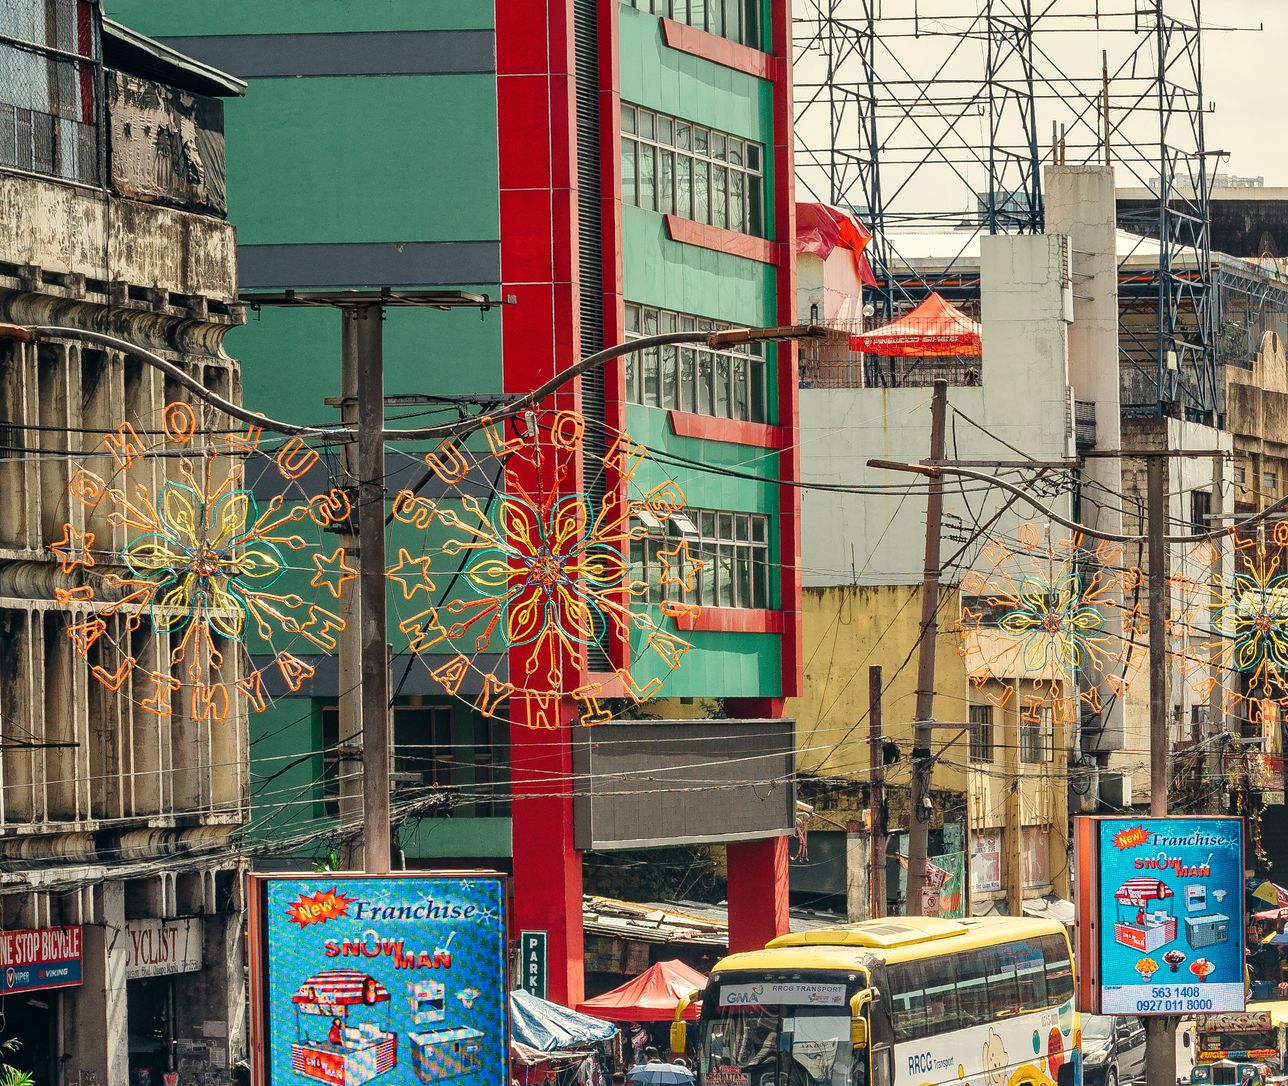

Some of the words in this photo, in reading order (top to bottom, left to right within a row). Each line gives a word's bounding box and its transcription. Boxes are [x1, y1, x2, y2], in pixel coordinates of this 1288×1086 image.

[1119, 831, 1144, 847] New!
[1153, 834, 1225, 847] Franchise
[1134, 852, 1182, 870] SNOW
[1175, 864, 1211, 877] MAN
[297, 893, 340, 921] New!
[354, 900, 477, 921] Franchise
[15, 932, 41, 964] STOP
[42, 928, 80, 961] BICYCLE
[324, 929, 405, 958] SNOW
[394, 948, 452, 969] MAN
[45, 968, 68, 978] VIKING
[727, 992, 759, 1003] GMA
[1152, 987, 1171, 998] 563
[1174, 986, 1200, 998] 1408
[1136, 1000, 1162, 1011] 0927
[1165, 1000, 1183, 1011] 011
[1186, 999, 1212, 1010] 8000
[908, 1051, 933, 1076] RRCG
[933, 1056, 954, 1070] Transport
